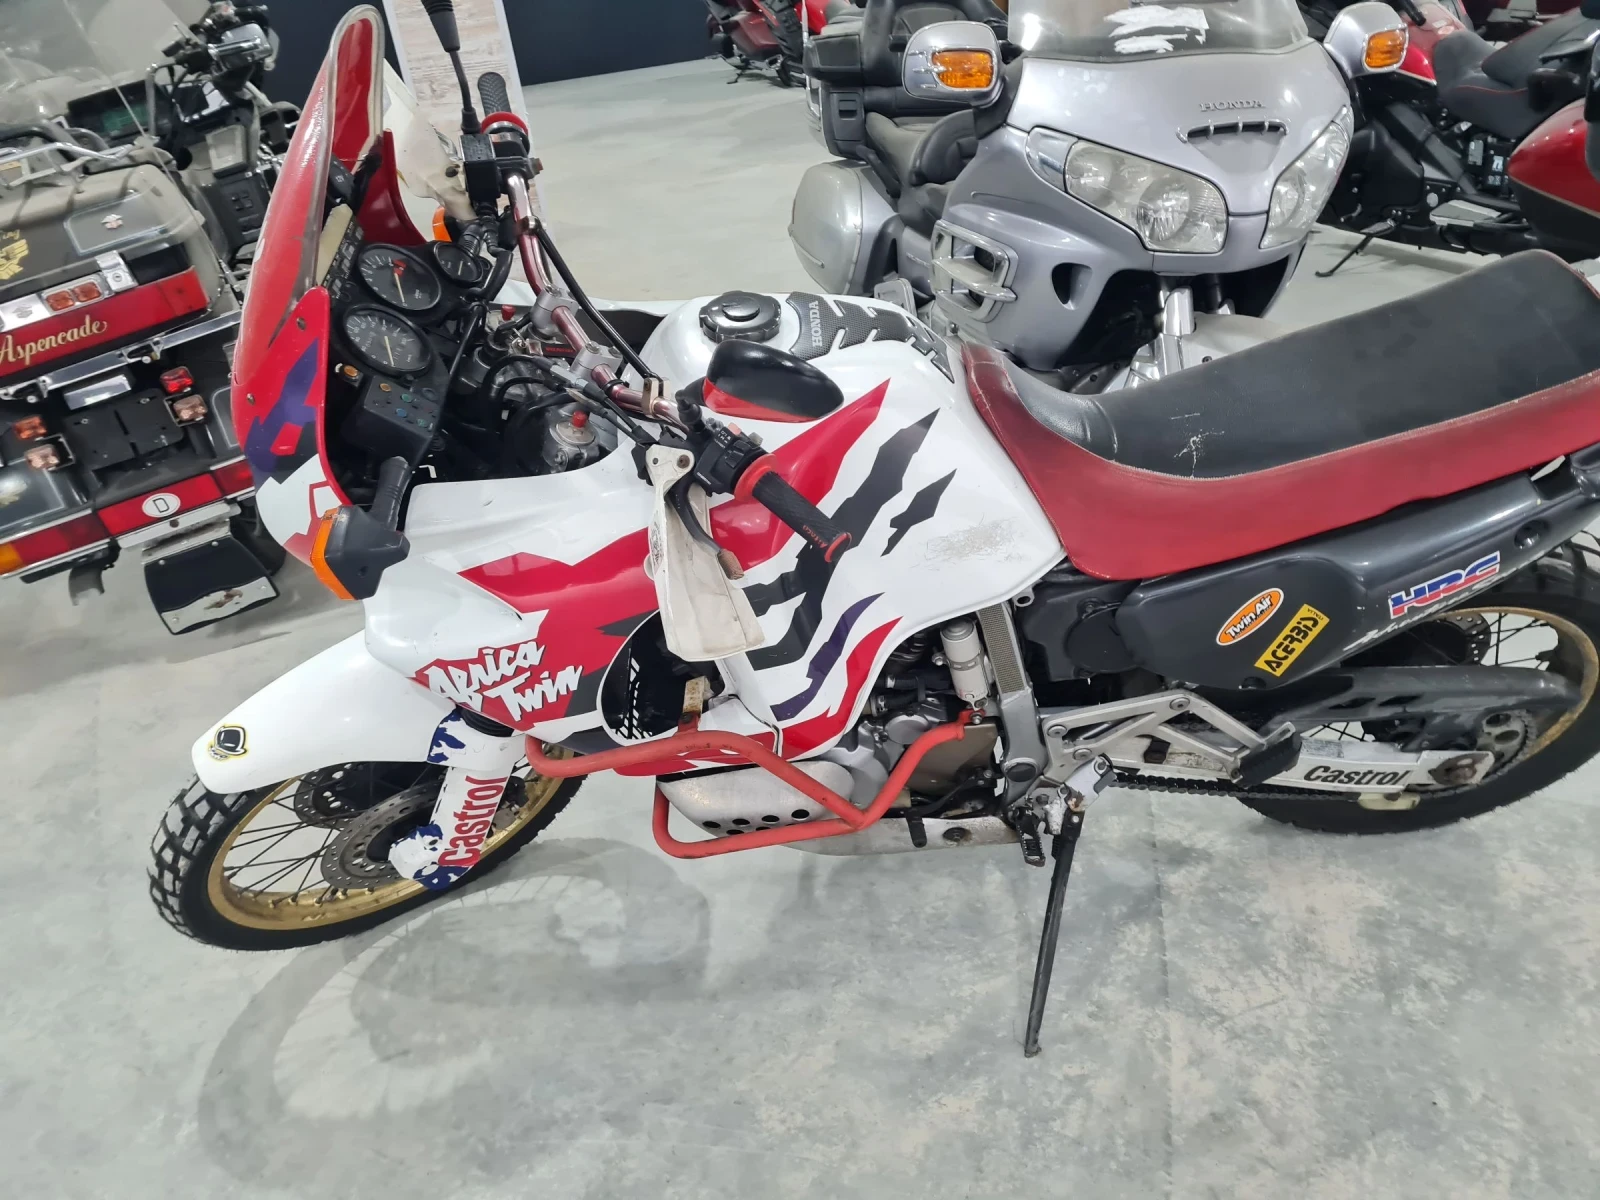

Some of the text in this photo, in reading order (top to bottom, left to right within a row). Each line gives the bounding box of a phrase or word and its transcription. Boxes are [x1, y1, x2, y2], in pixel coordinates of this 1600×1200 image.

[1199, 100, 1266, 112] HONDA
[0, 315, 108, 365] Aspencade
[808, 300, 823, 347] HONDA
[152, 497, 170, 513] D
[1388, 550, 1500, 619] HRC
[1225, 594, 1274, 639] Twin Air
[1264, 616, 1319, 672] ACERBIS
[482, 664, 583, 722] Twin
[1303, 765, 1411, 785] Castrol
[438, 775, 509, 867] Castrol
